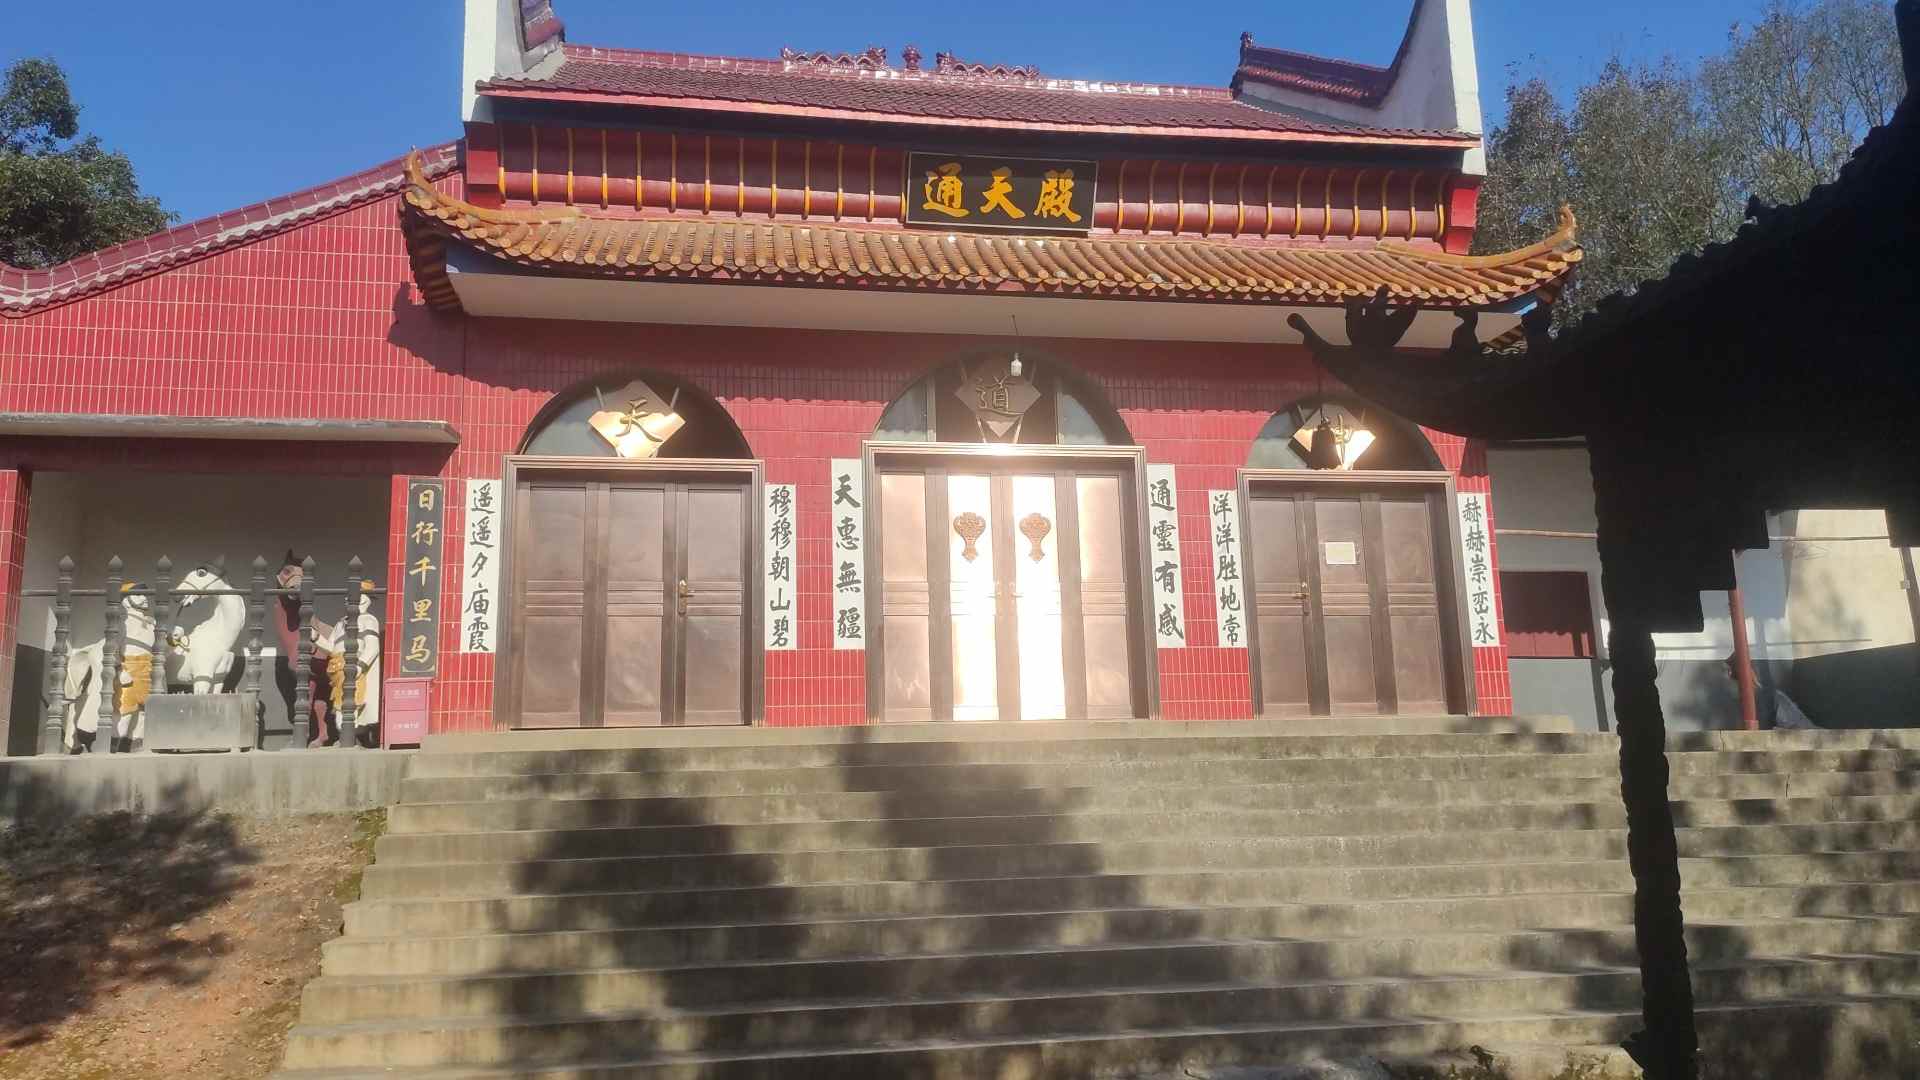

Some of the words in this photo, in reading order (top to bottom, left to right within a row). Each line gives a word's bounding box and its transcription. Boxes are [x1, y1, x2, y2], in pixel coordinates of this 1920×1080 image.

[922, 162, 1082, 223] 通天殿
[615, 398, 664, 443] 天
[975, 376, 1025, 417] 道
[405, 488, 439, 664] 日行千里马
[464, 482, 496, 652] 遥遥夕庙霞
[768, 485, 793, 648] 穆穆朝山碧
[834, 473, 862, 639] 天惠無疆
[1149, 478, 1184, 640] 通靈有感
[1212, 492, 1241, 647] 洋洋胜地常
[1462, 496, 1495, 644] 赫赫崇峦永
